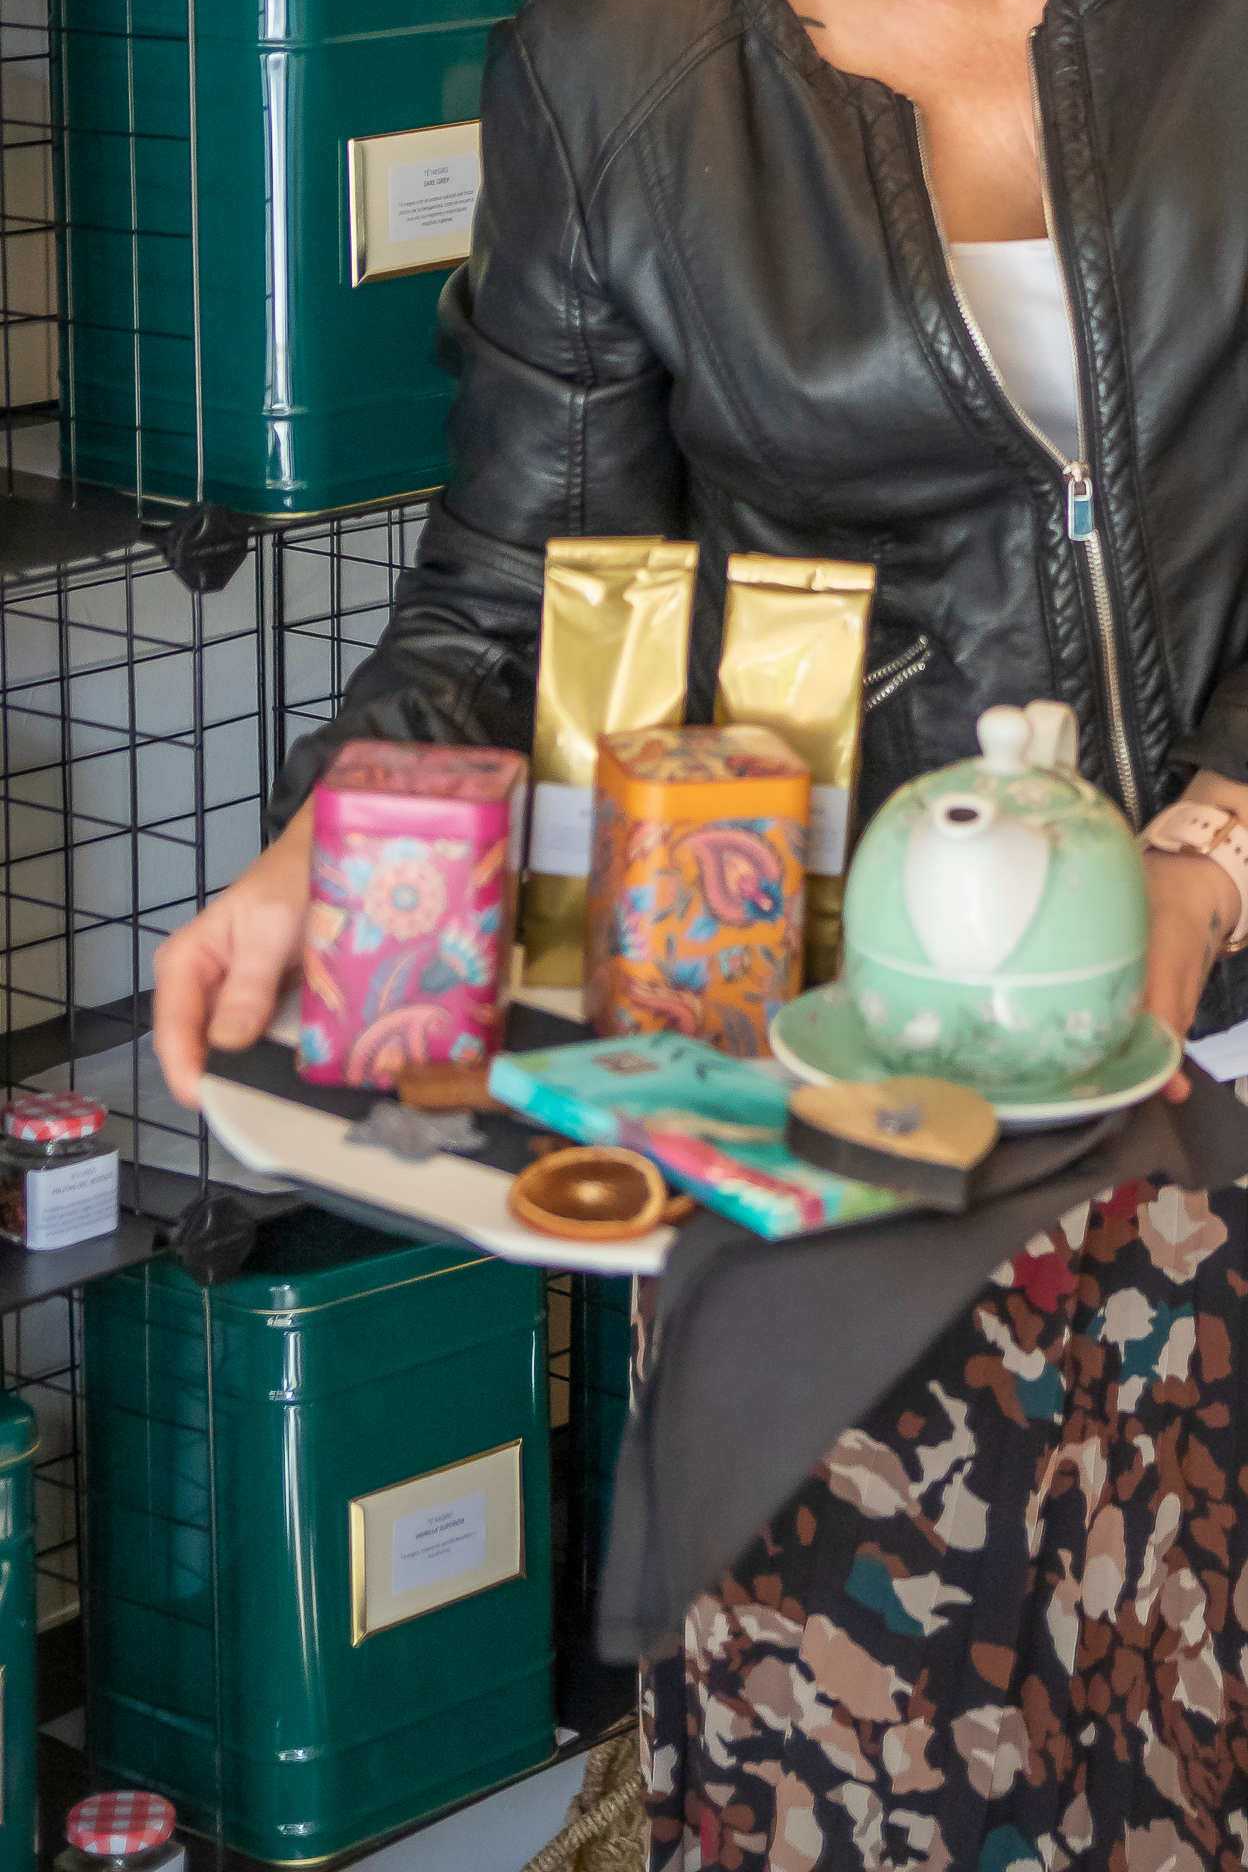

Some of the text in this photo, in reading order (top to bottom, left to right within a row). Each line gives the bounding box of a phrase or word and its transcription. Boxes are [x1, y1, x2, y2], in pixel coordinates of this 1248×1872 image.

[430, 167, 449, 176] NEGRO
[423, 177, 450, 188] EARL GREY
